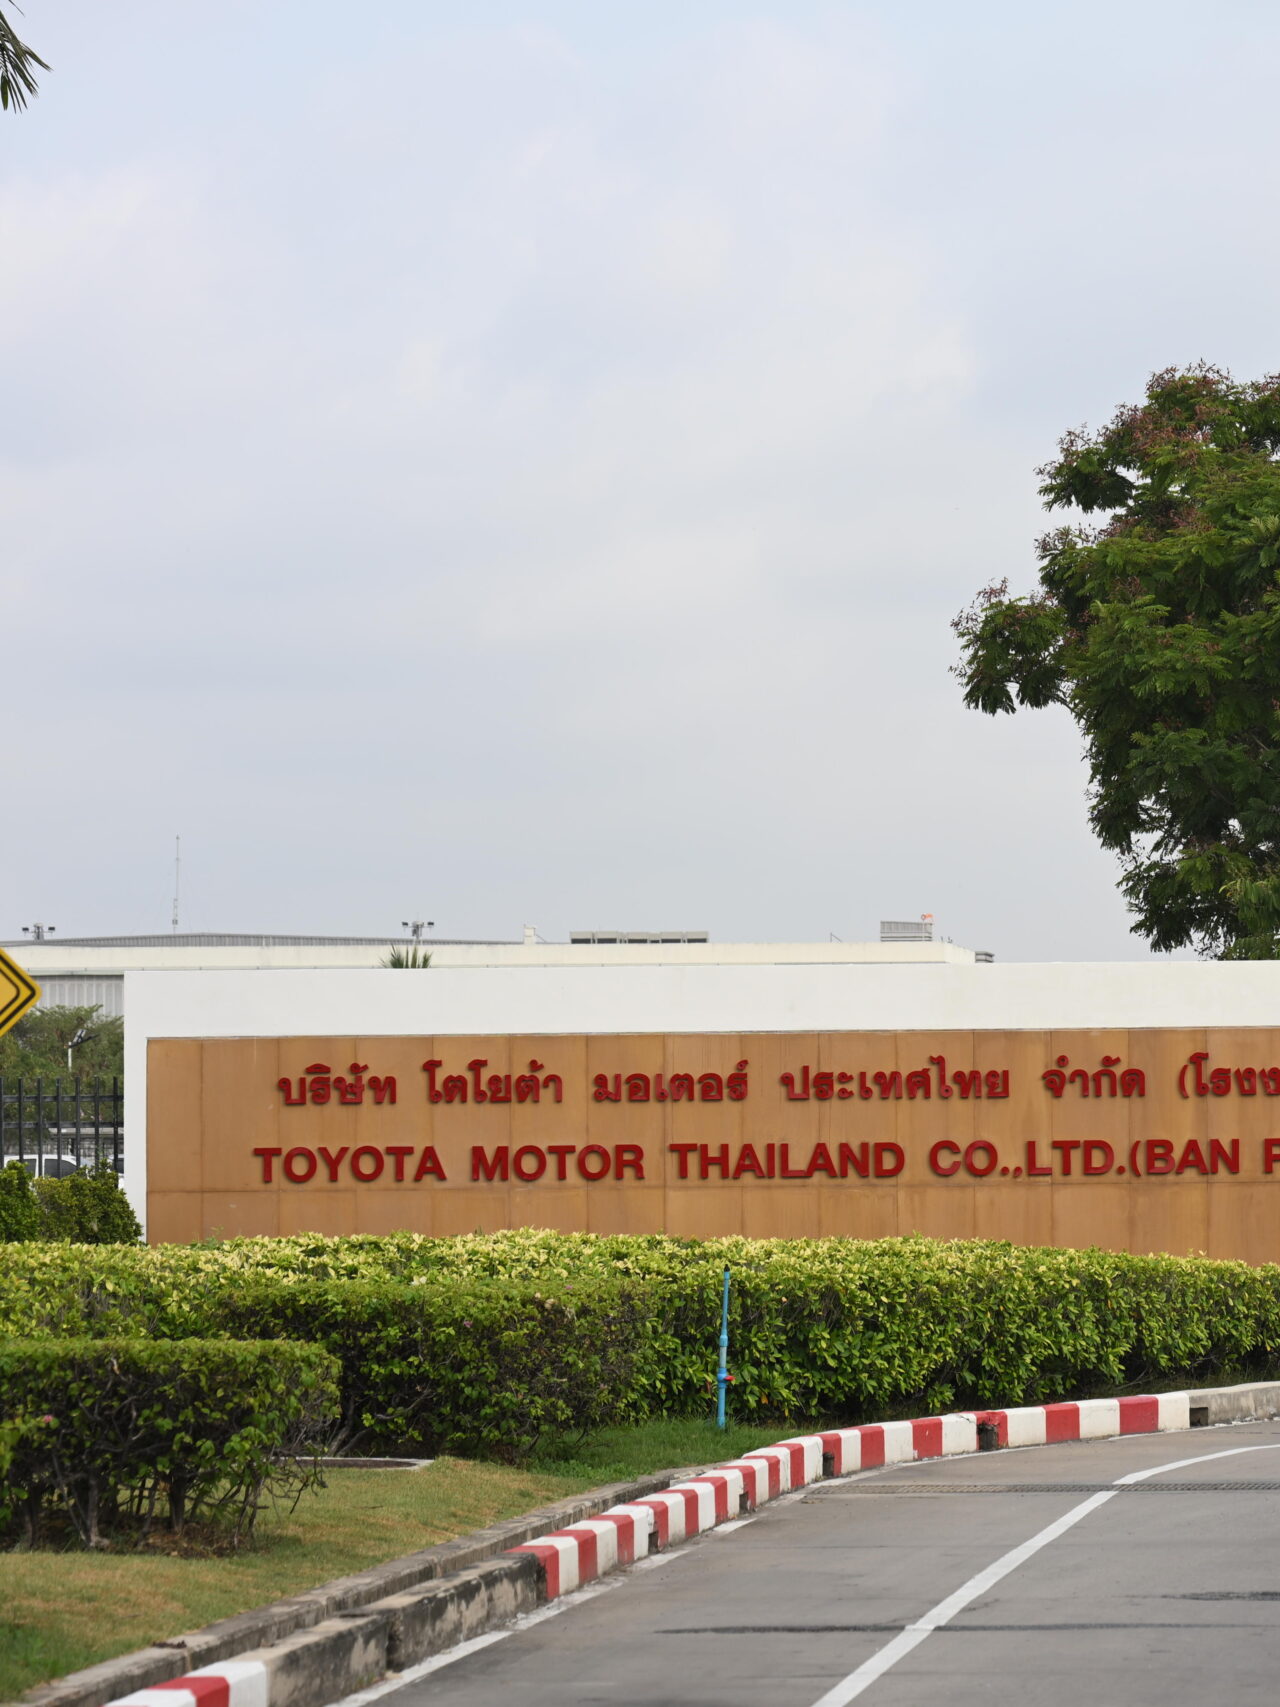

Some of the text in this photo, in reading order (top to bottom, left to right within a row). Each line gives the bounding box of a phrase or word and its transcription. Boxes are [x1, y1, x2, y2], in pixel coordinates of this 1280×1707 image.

[277, 1062, 397, 1105] บริษัท
[421, 1058, 563, 1103] โตโยต้า
[592, 1059, 749, 1102] มอเตอร์
[779, 1055, 1010, 1100] ประเทศไทย
[1041, 1054, 1146, 1097] จำกัด
[252, 1145, 447, 1184] TOYOTA
[471, 1144, 645, 1182] MOTOR
[668, 1141, 906, 1180] THAILAND
